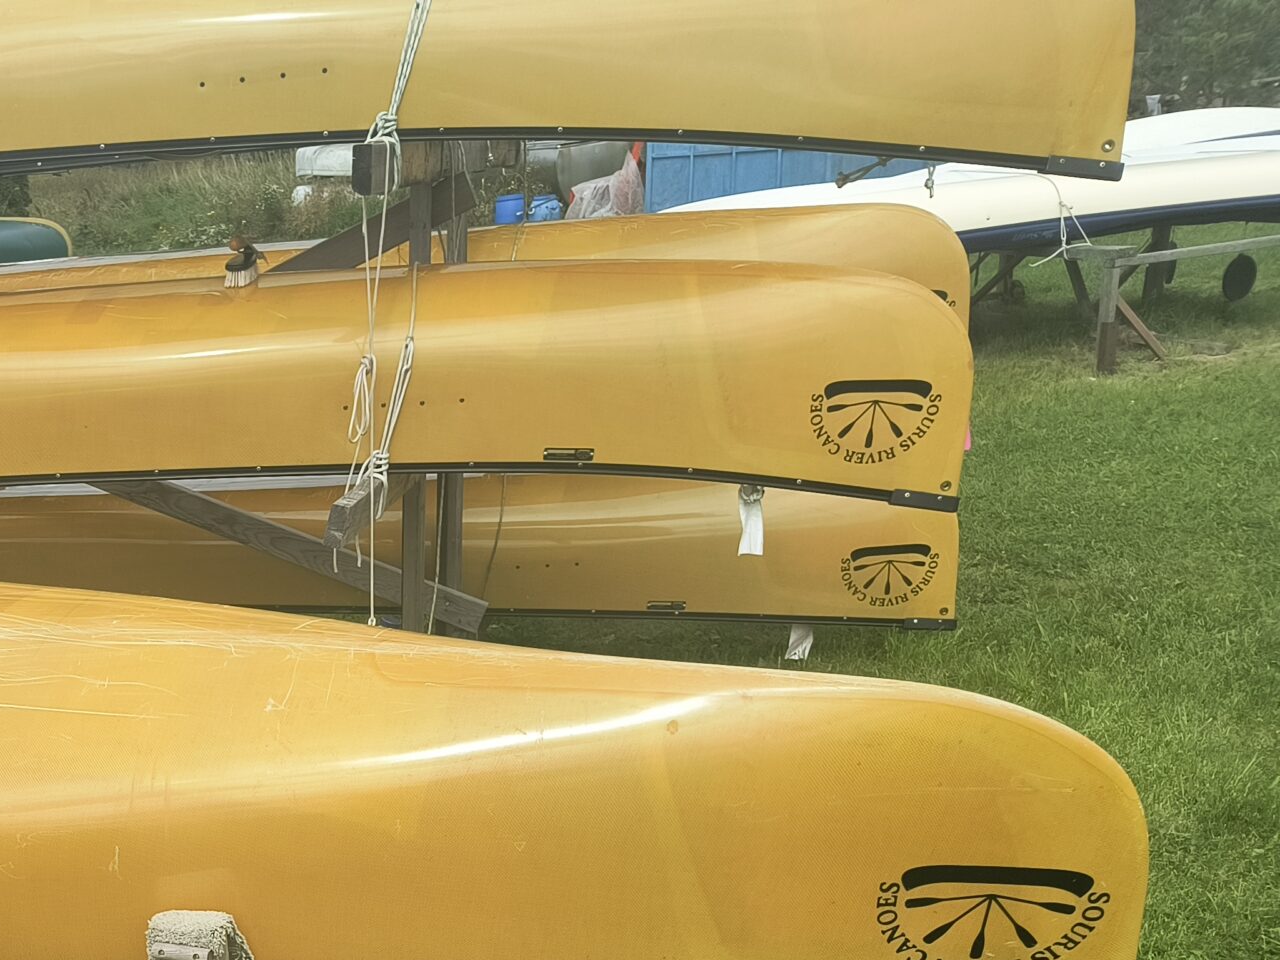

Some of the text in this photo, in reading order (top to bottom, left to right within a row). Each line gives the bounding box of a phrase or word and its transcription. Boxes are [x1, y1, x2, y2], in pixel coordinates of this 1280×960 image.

[810, 393, 942, 464] SOURIS RIVER CANOES
[841, 553, 940, 607] SOURIS RIVER CANOES
